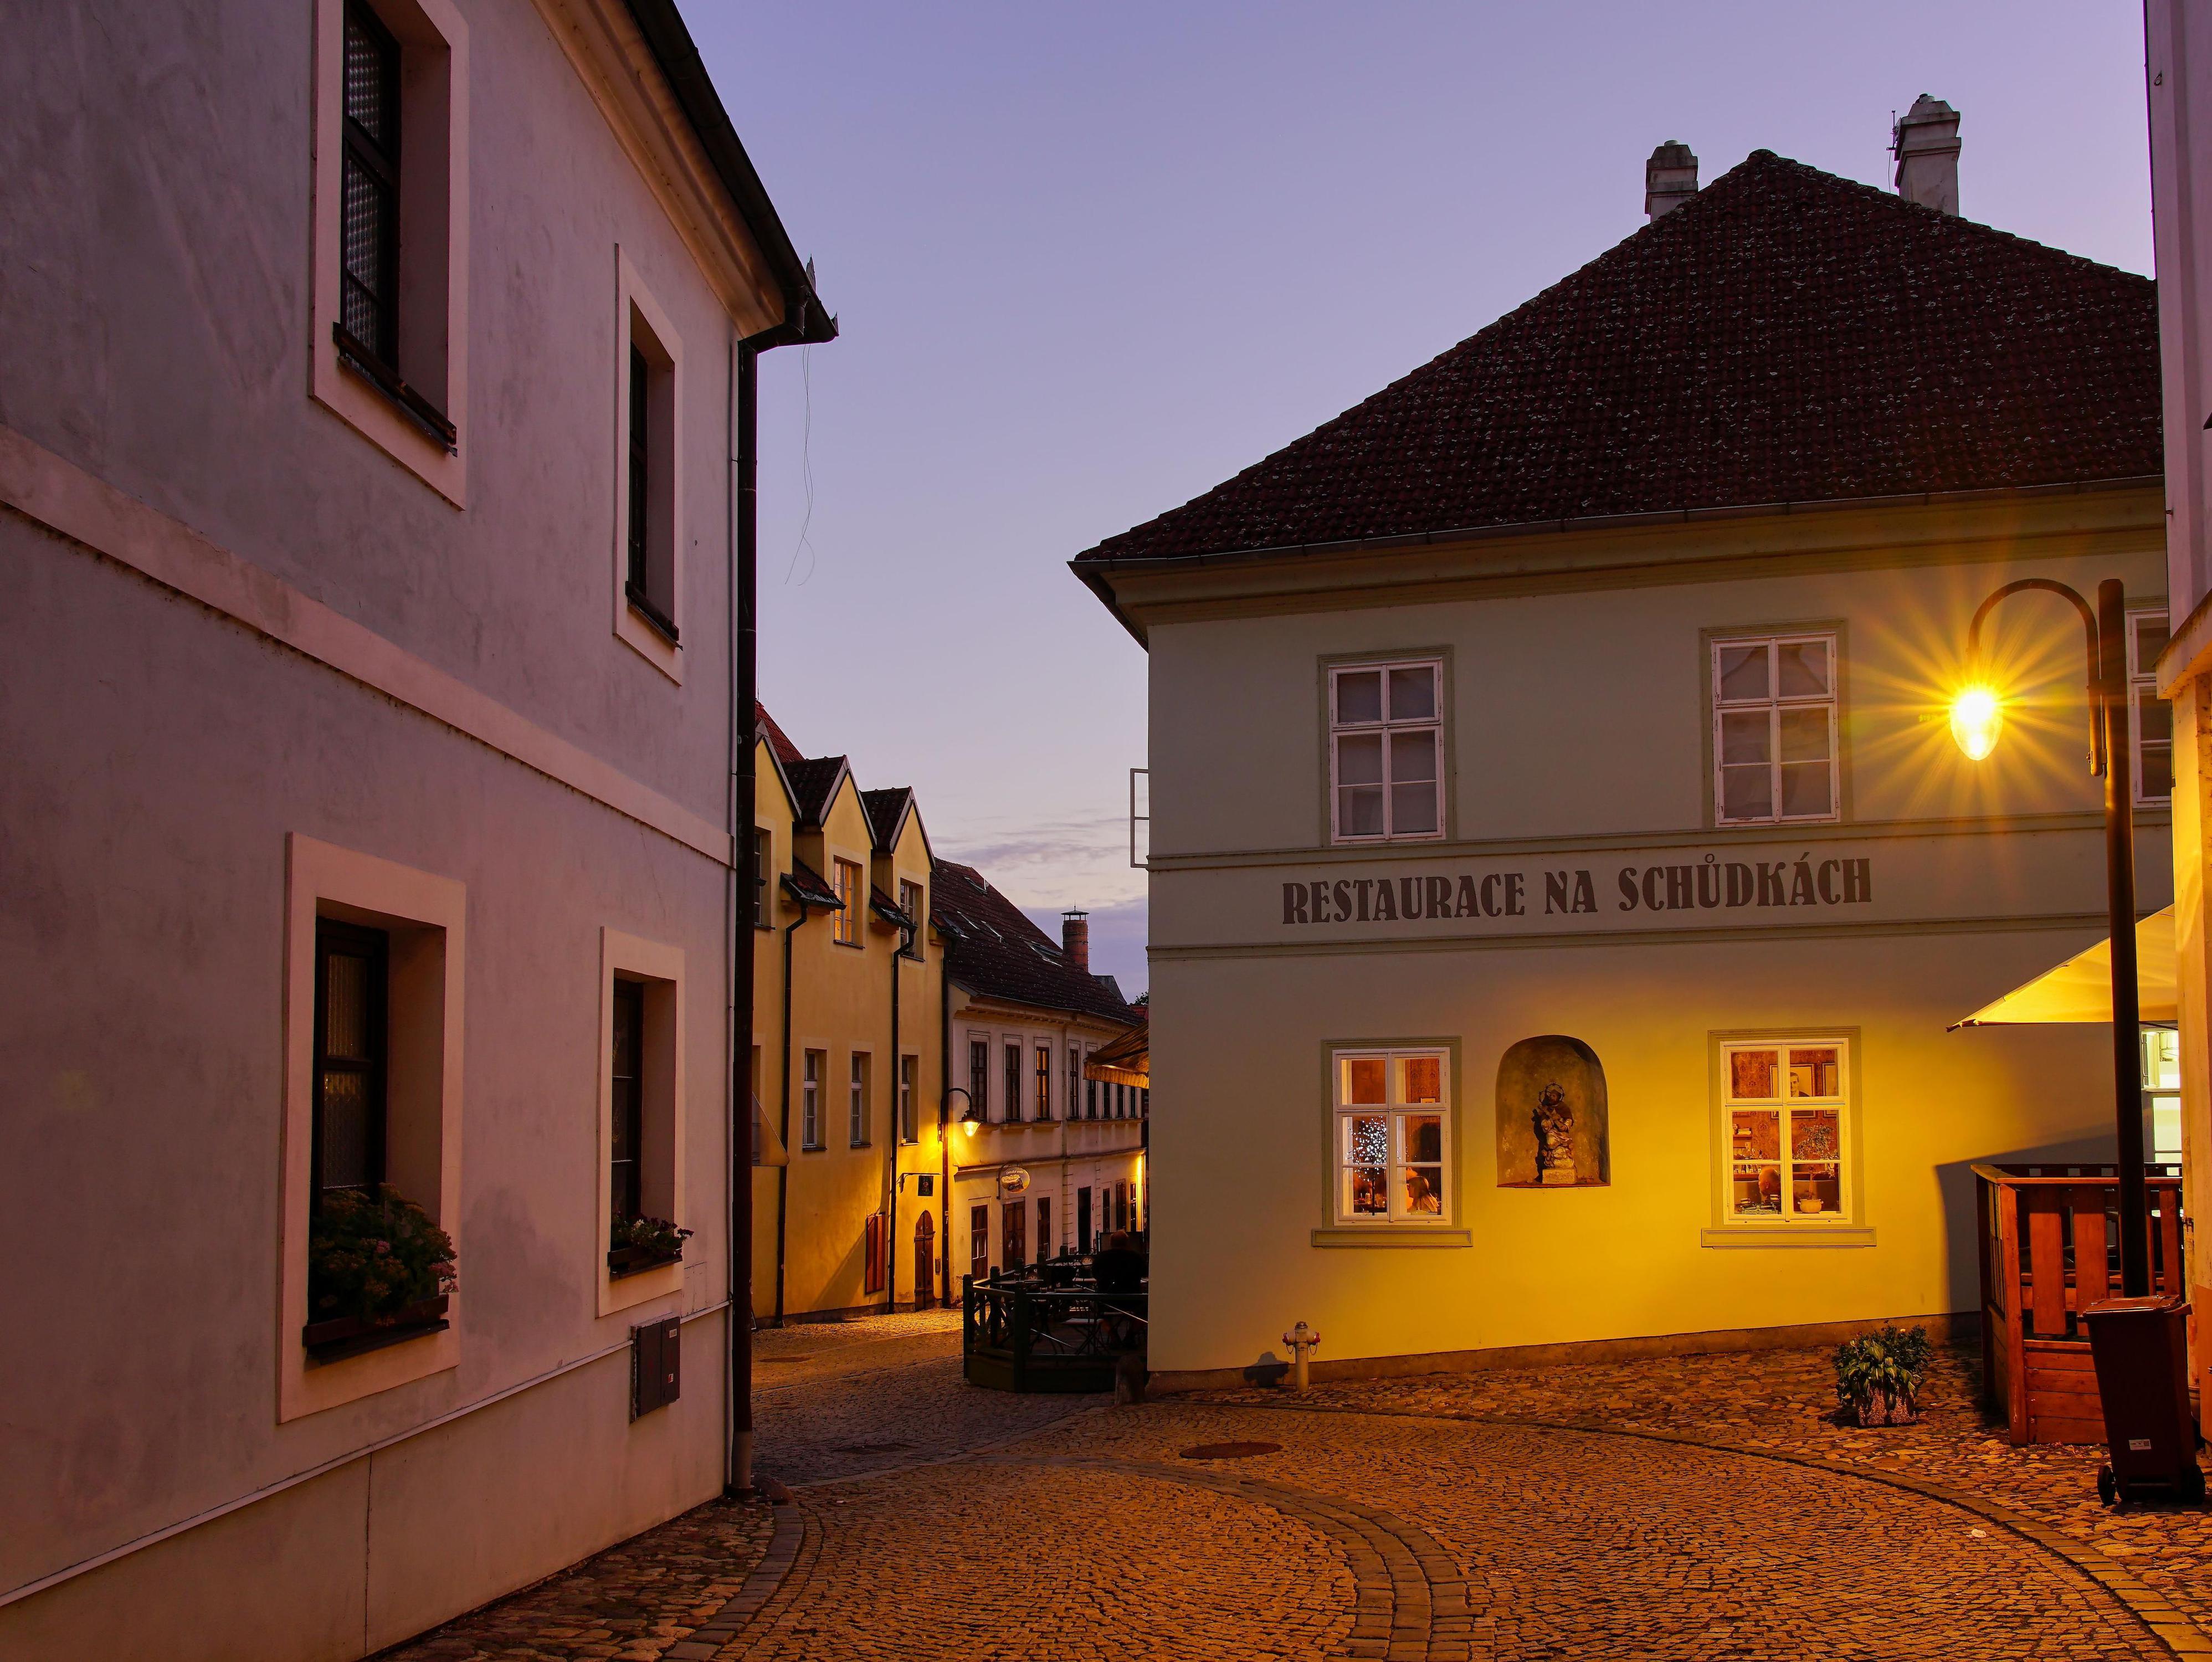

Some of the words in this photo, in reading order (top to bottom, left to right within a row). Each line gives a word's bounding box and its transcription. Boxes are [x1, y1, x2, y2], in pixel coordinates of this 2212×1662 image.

[1282, 873, 1525, 925] RESTAURACE
[1544, 870, 1598, 915] NA
[1618, 852, 1872, 911] SCHŮDKÁCH
